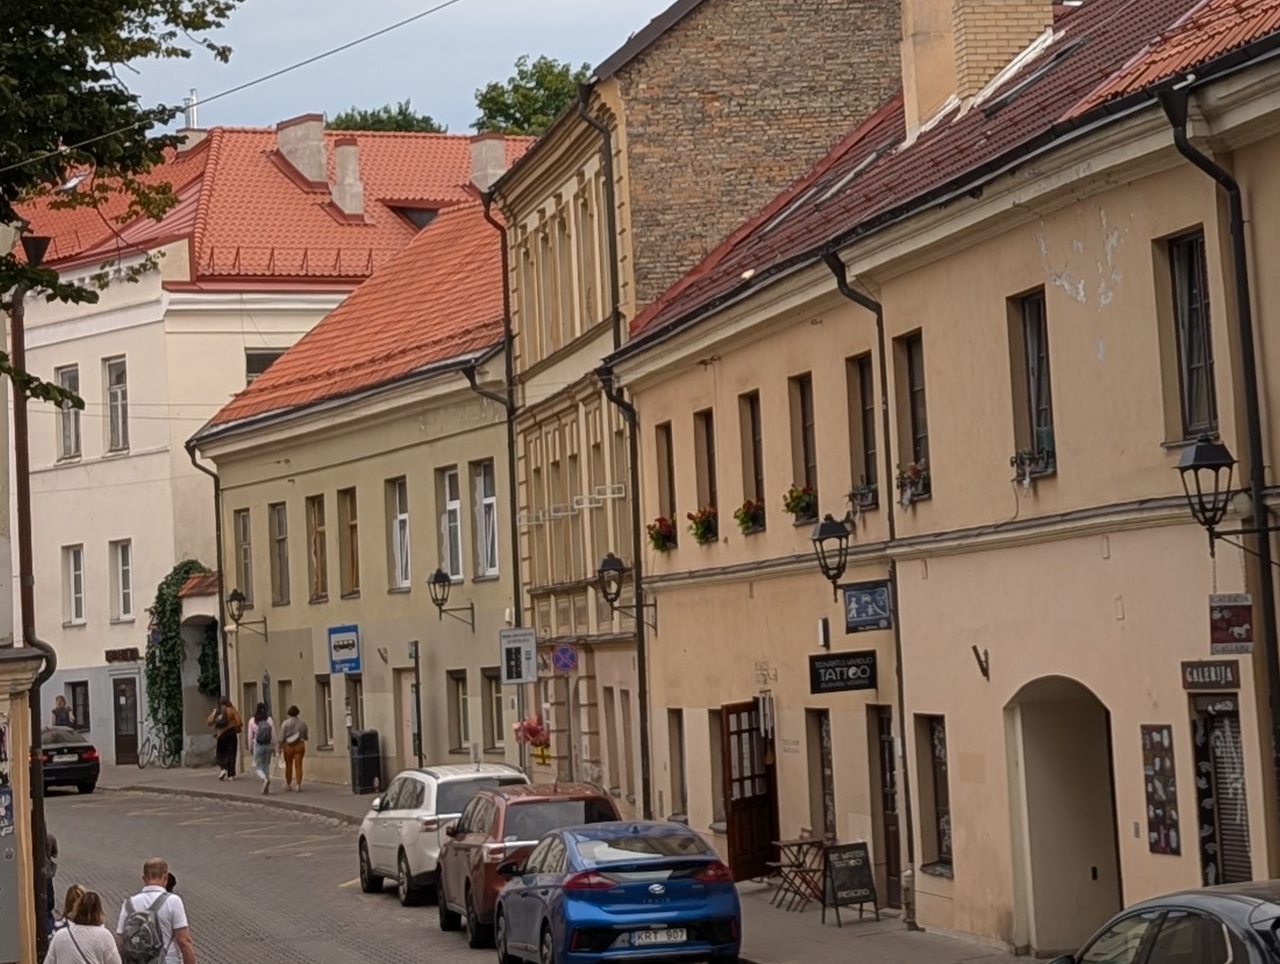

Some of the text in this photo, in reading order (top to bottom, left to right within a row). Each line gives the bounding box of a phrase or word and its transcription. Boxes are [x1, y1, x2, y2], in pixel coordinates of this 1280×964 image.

[819, 664, 871, 682] TATTOO
[1186, 666, 1233, 684] GALERIJA
[637, 929, 685, 942] KRT 907
